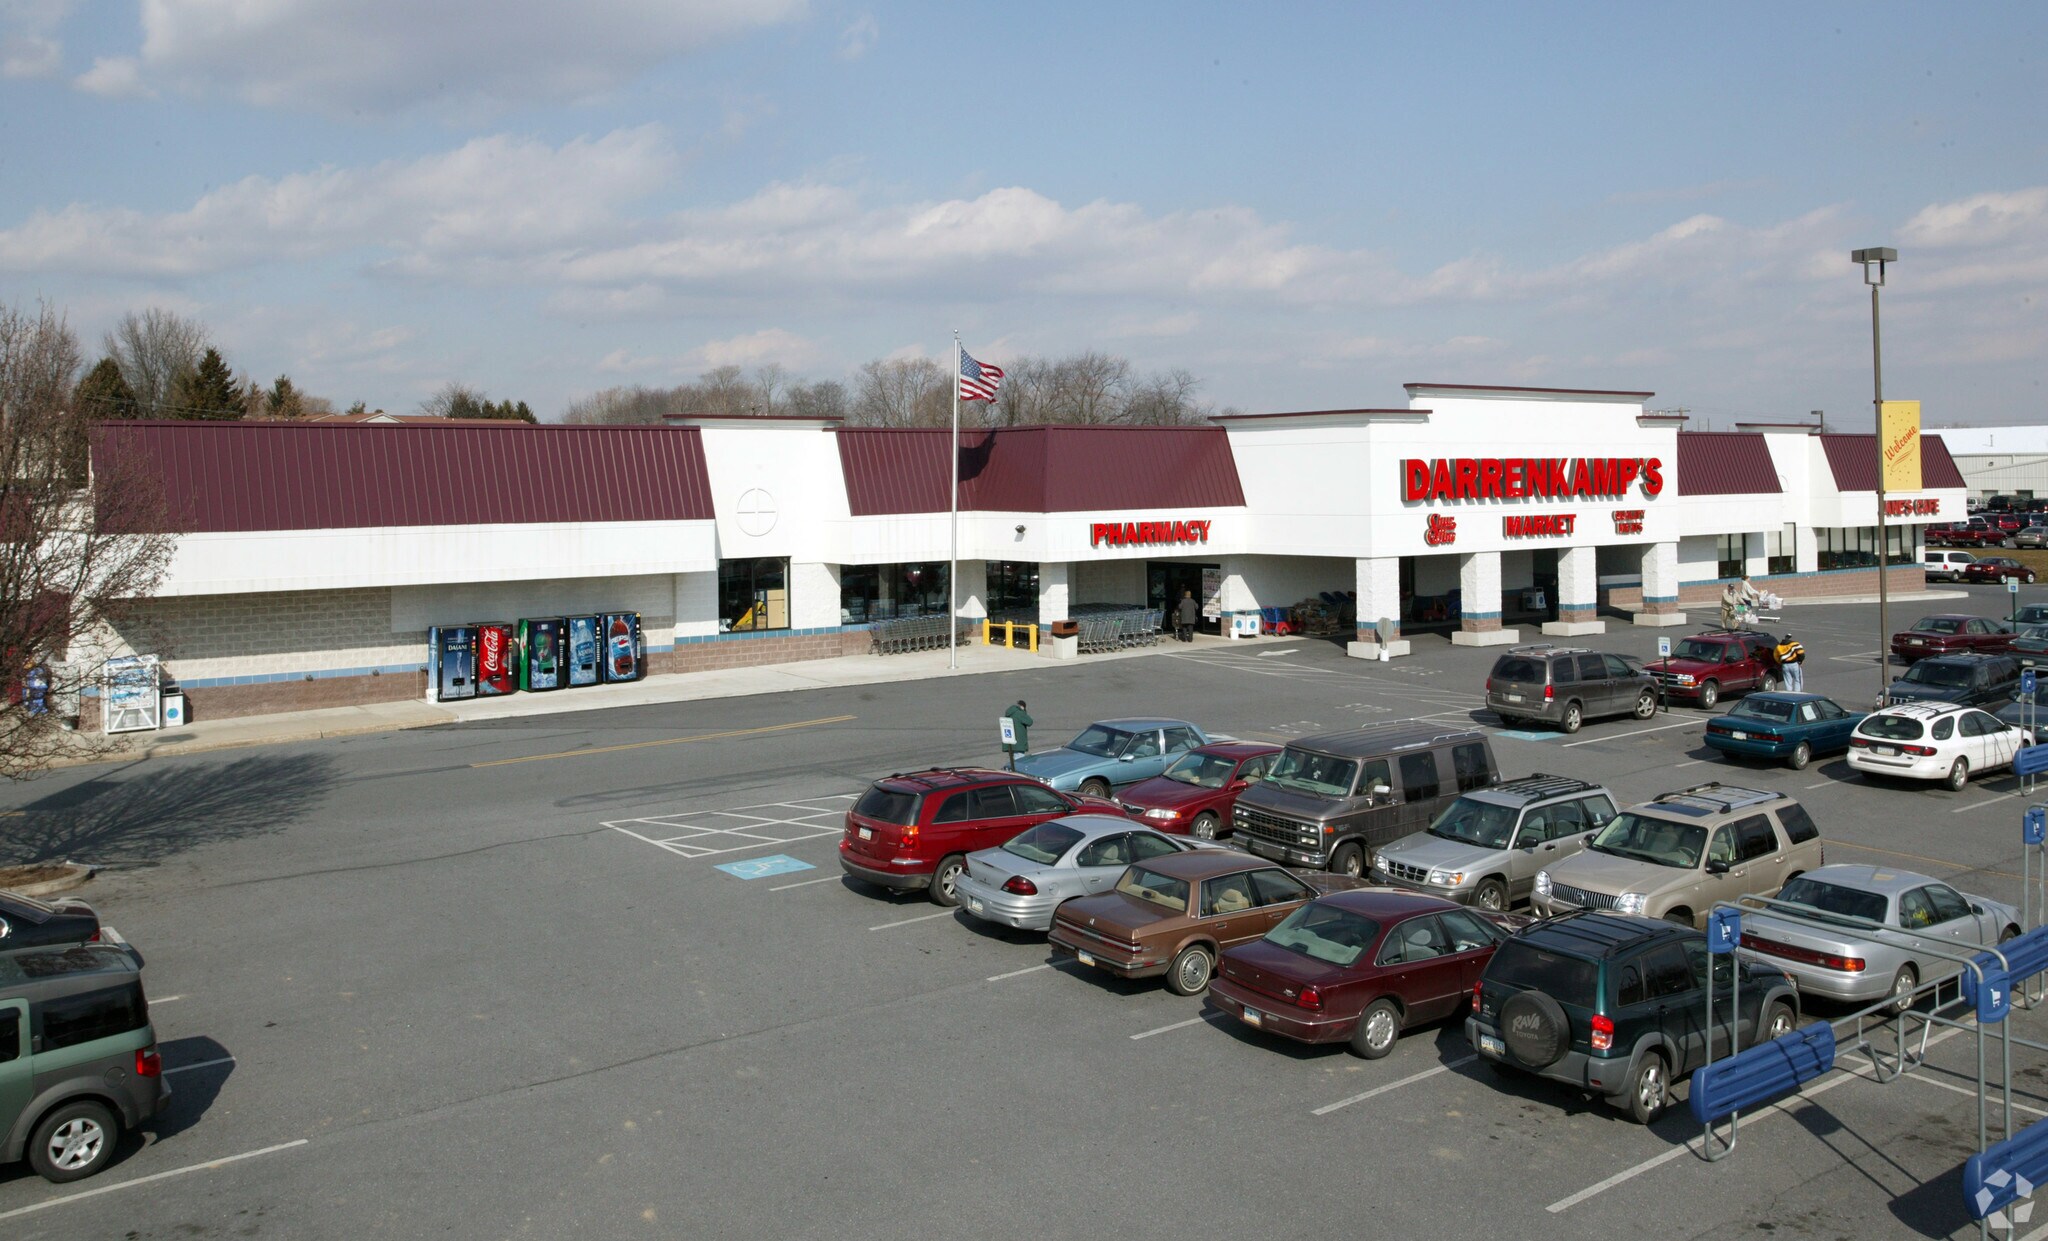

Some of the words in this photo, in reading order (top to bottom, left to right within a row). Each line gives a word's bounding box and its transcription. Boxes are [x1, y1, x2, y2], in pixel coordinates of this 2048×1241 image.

[1884, 425, 1918, 461] Welcome
[1400, 457, 1663, 502] DARRENKAMP'S
[1913, 498, 1940, 515] CAFE
[1090, 520, 1211, 546] PHARMACY
[1503, 514, 1577, 537] MARKET
[1516, 1030, 1540, 1040] TOYOTA
